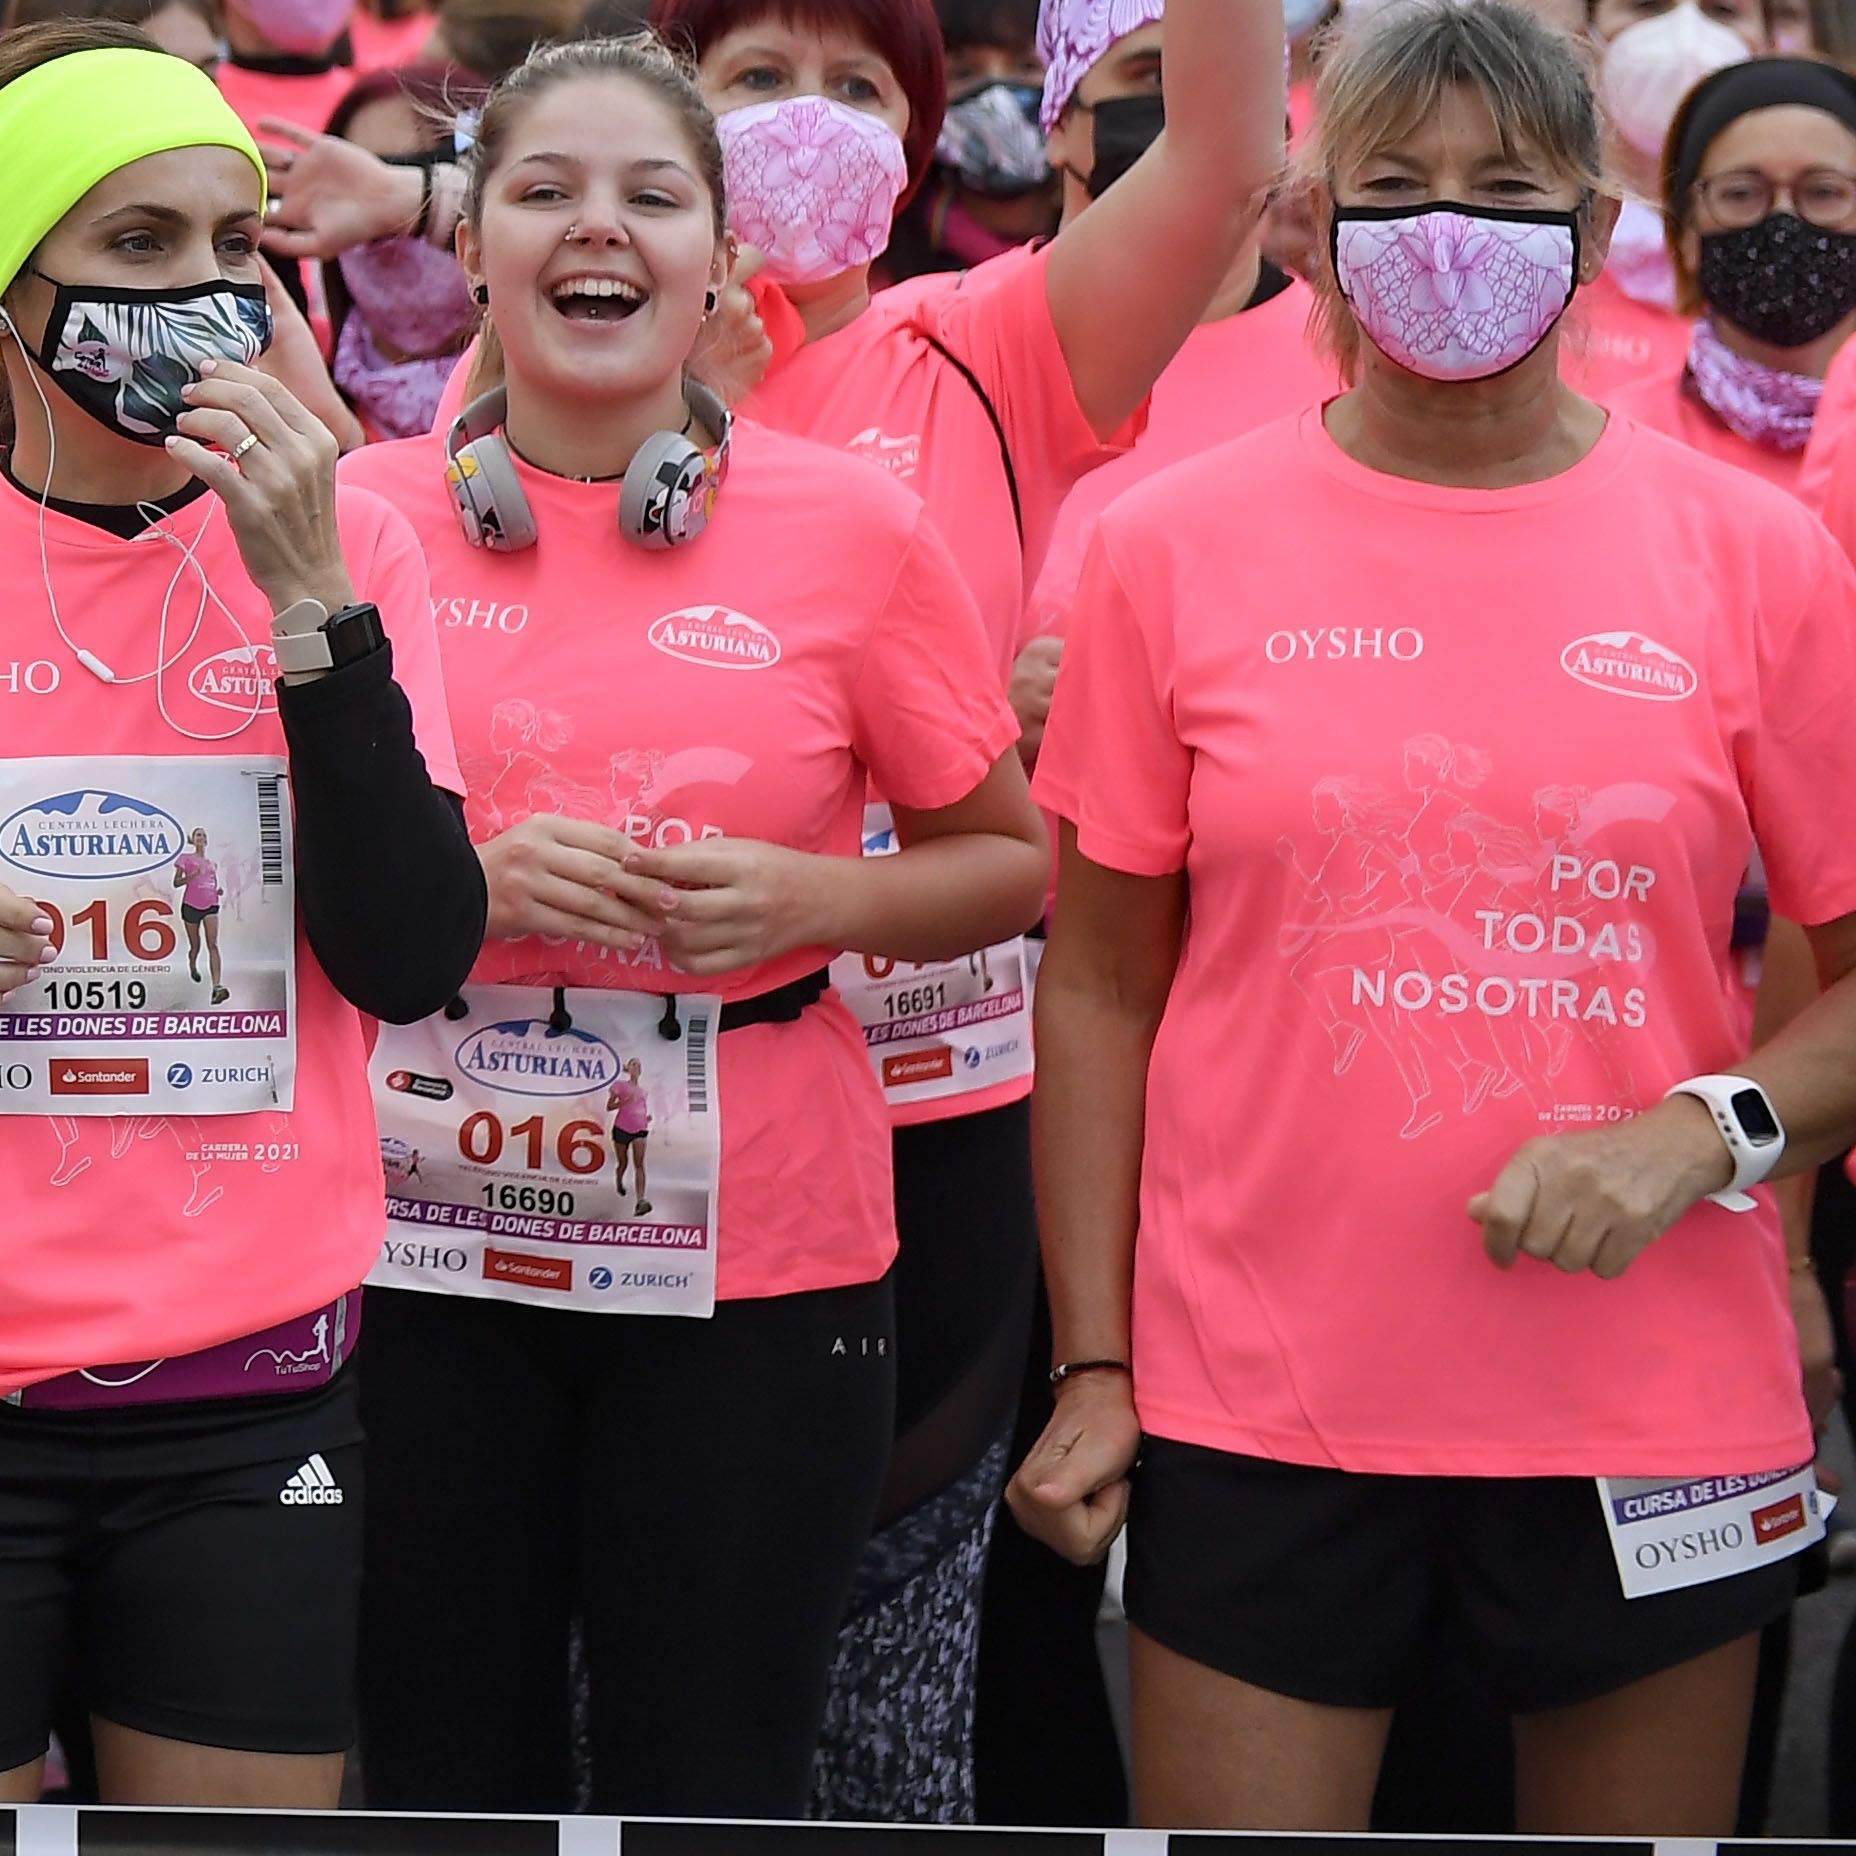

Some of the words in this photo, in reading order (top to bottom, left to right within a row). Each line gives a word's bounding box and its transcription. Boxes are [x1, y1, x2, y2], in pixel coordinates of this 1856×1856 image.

[430, 597, 528, 634] YSHO
[660, 623, 770, 661] ASTURIANA
[1265, 627, 1424, 664] OYSHO
[1572, 648, 1684, 693] ASTURIANA
[10, 824, 172, 856] ASTURIANA
[38, 820, 98, 831] CENTRAL
[1551, 854, 1656, 902] POR
[1475, 910, 1643, 963] TODAS
[44, 980, 146, 1011] 10519
[884, 982, 945, 1017] 16691
[1352, 967, 1646, 1028] NOSOTRAS
[14, 1017, 51, 1035] LES
[59, 1016, 126, 1035] DONES
[131, 1015, 159, 1034] DE
[164, 1014, 281, 1034] BARCELONA
[892, 1017, 938, 1040] DONES
[939, 1012, 955, 1029] DE
[958, 994, 1021, 1023] BARCELONA
[78, 1070, 136, 1084] Santander
[202, 1067, 270, 1084] ZURICH
[466, 1041, 606, 1080] ASTURIANA
[253, 1143, 299, 1160] 2021
[458, 1112, 605, 1174] 016
[482, 1184, 574, 1216] 16690
[385, 1201, 421, 1220] RSA
[426, 1204, 452, 1222] DE
[456, 1210, 486, 1227] LES
[492, 1215, 554, 1238] DONES
[559, 1222, 582, 1240] DE
[589, 1226, 702, 1245] BARCELONA
[384, 1241, 466, 1271] YSHO
[621, 1273, 688, 1288] ZURICH
[280, 1485, 343, 1505] adidas
[1624, 1486, 1687, 1519] CURSA
[1691, 1479, 1715, 1503] DE
[1718, 1474, 1748, 1498] LES
[1635, 1522, 1742, 1569] OYSHO
